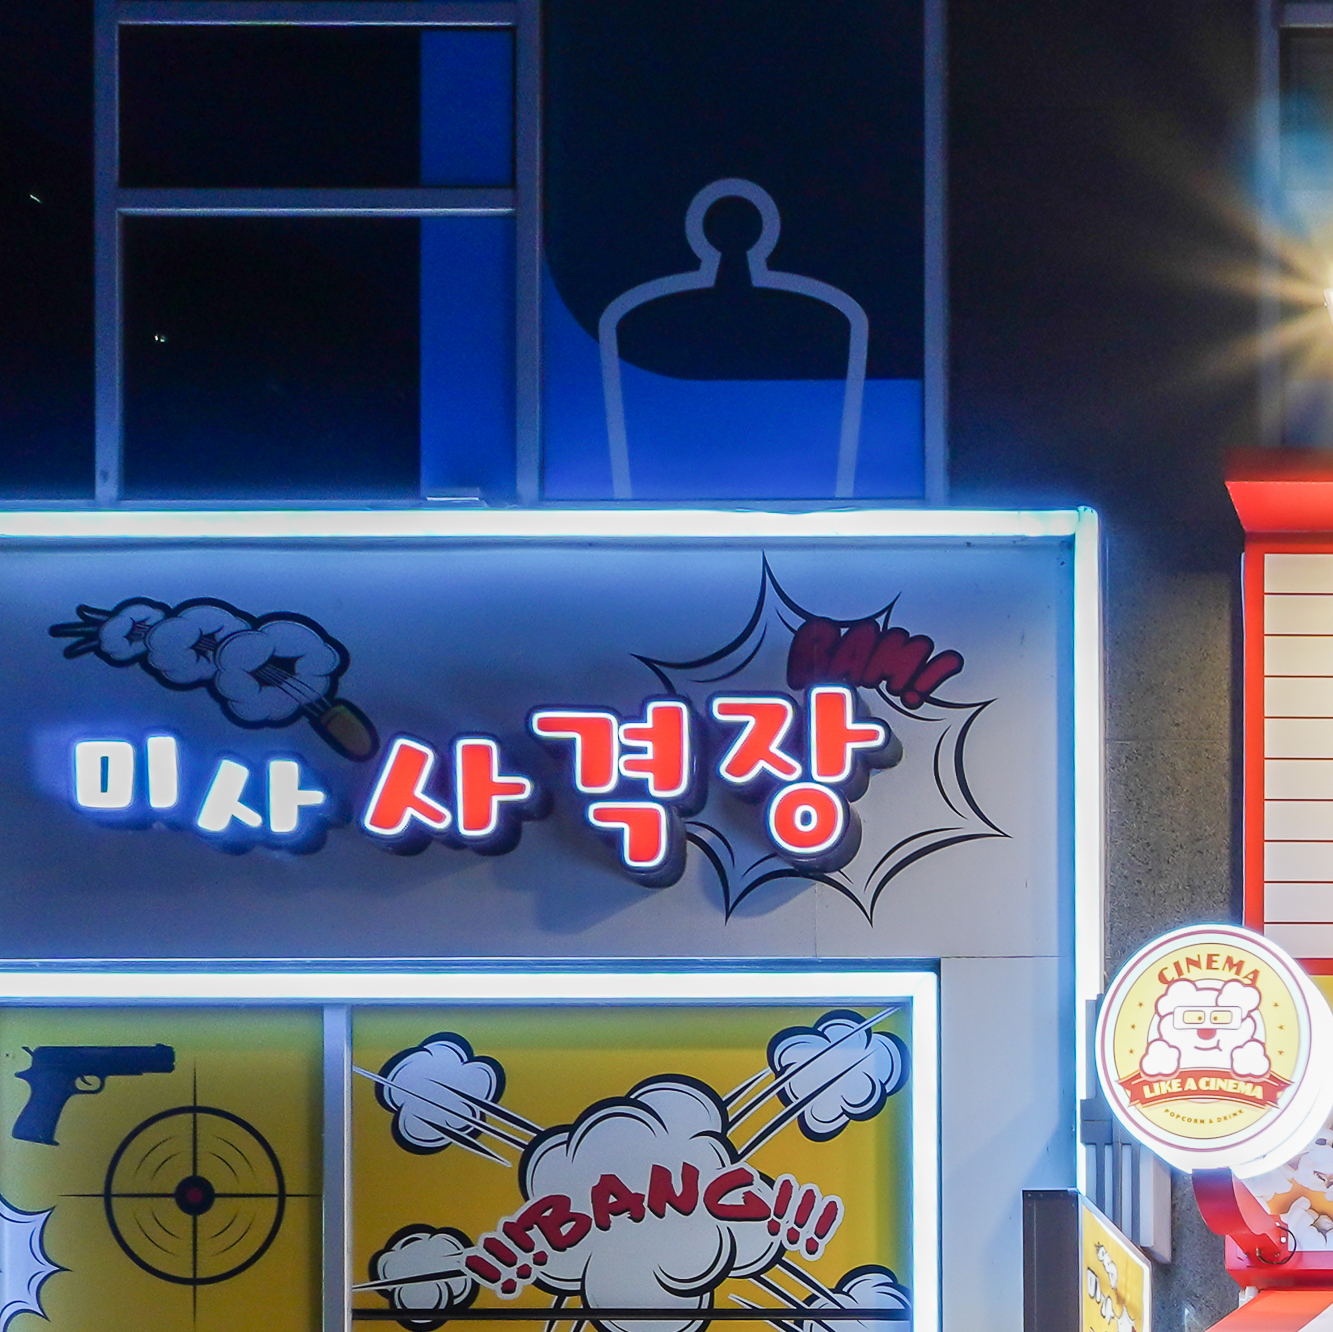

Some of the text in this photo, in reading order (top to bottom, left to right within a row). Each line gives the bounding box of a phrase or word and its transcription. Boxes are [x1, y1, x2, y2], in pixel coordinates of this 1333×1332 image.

[785, 617, 965, 709] BAM!
[74, 685, 887, 869] 미사 사격장
[1157, 953, 1261, 987] CINEMA
[1143, 1077, 1264, 1100] LIKE A CINEMA
[1164, 1109, 1206, 1125] POPCORN
[1216, 1109, 1245, 1123] DRINK
